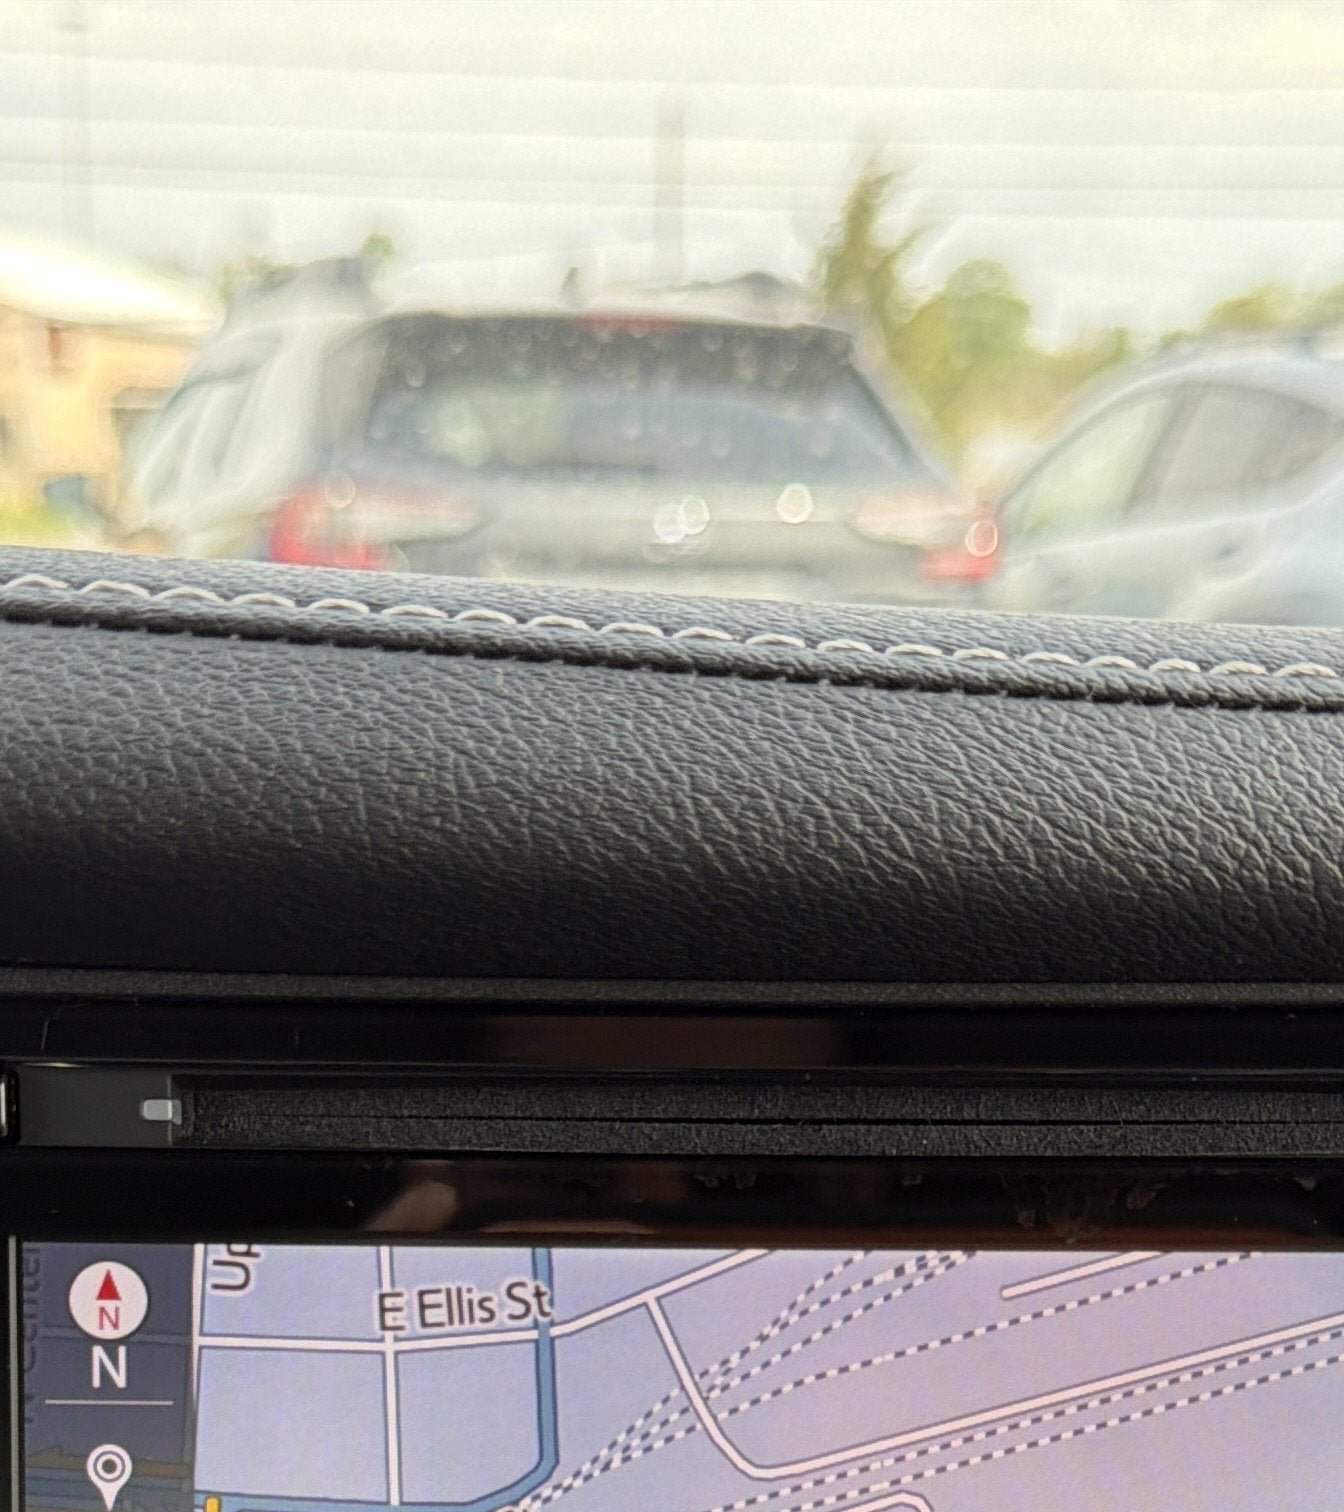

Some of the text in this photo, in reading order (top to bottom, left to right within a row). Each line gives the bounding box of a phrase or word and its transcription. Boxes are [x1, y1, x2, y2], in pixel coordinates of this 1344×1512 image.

[379, 1282, 552, 1331] E Ellis St
[92, 1345, 127, 1389] N
